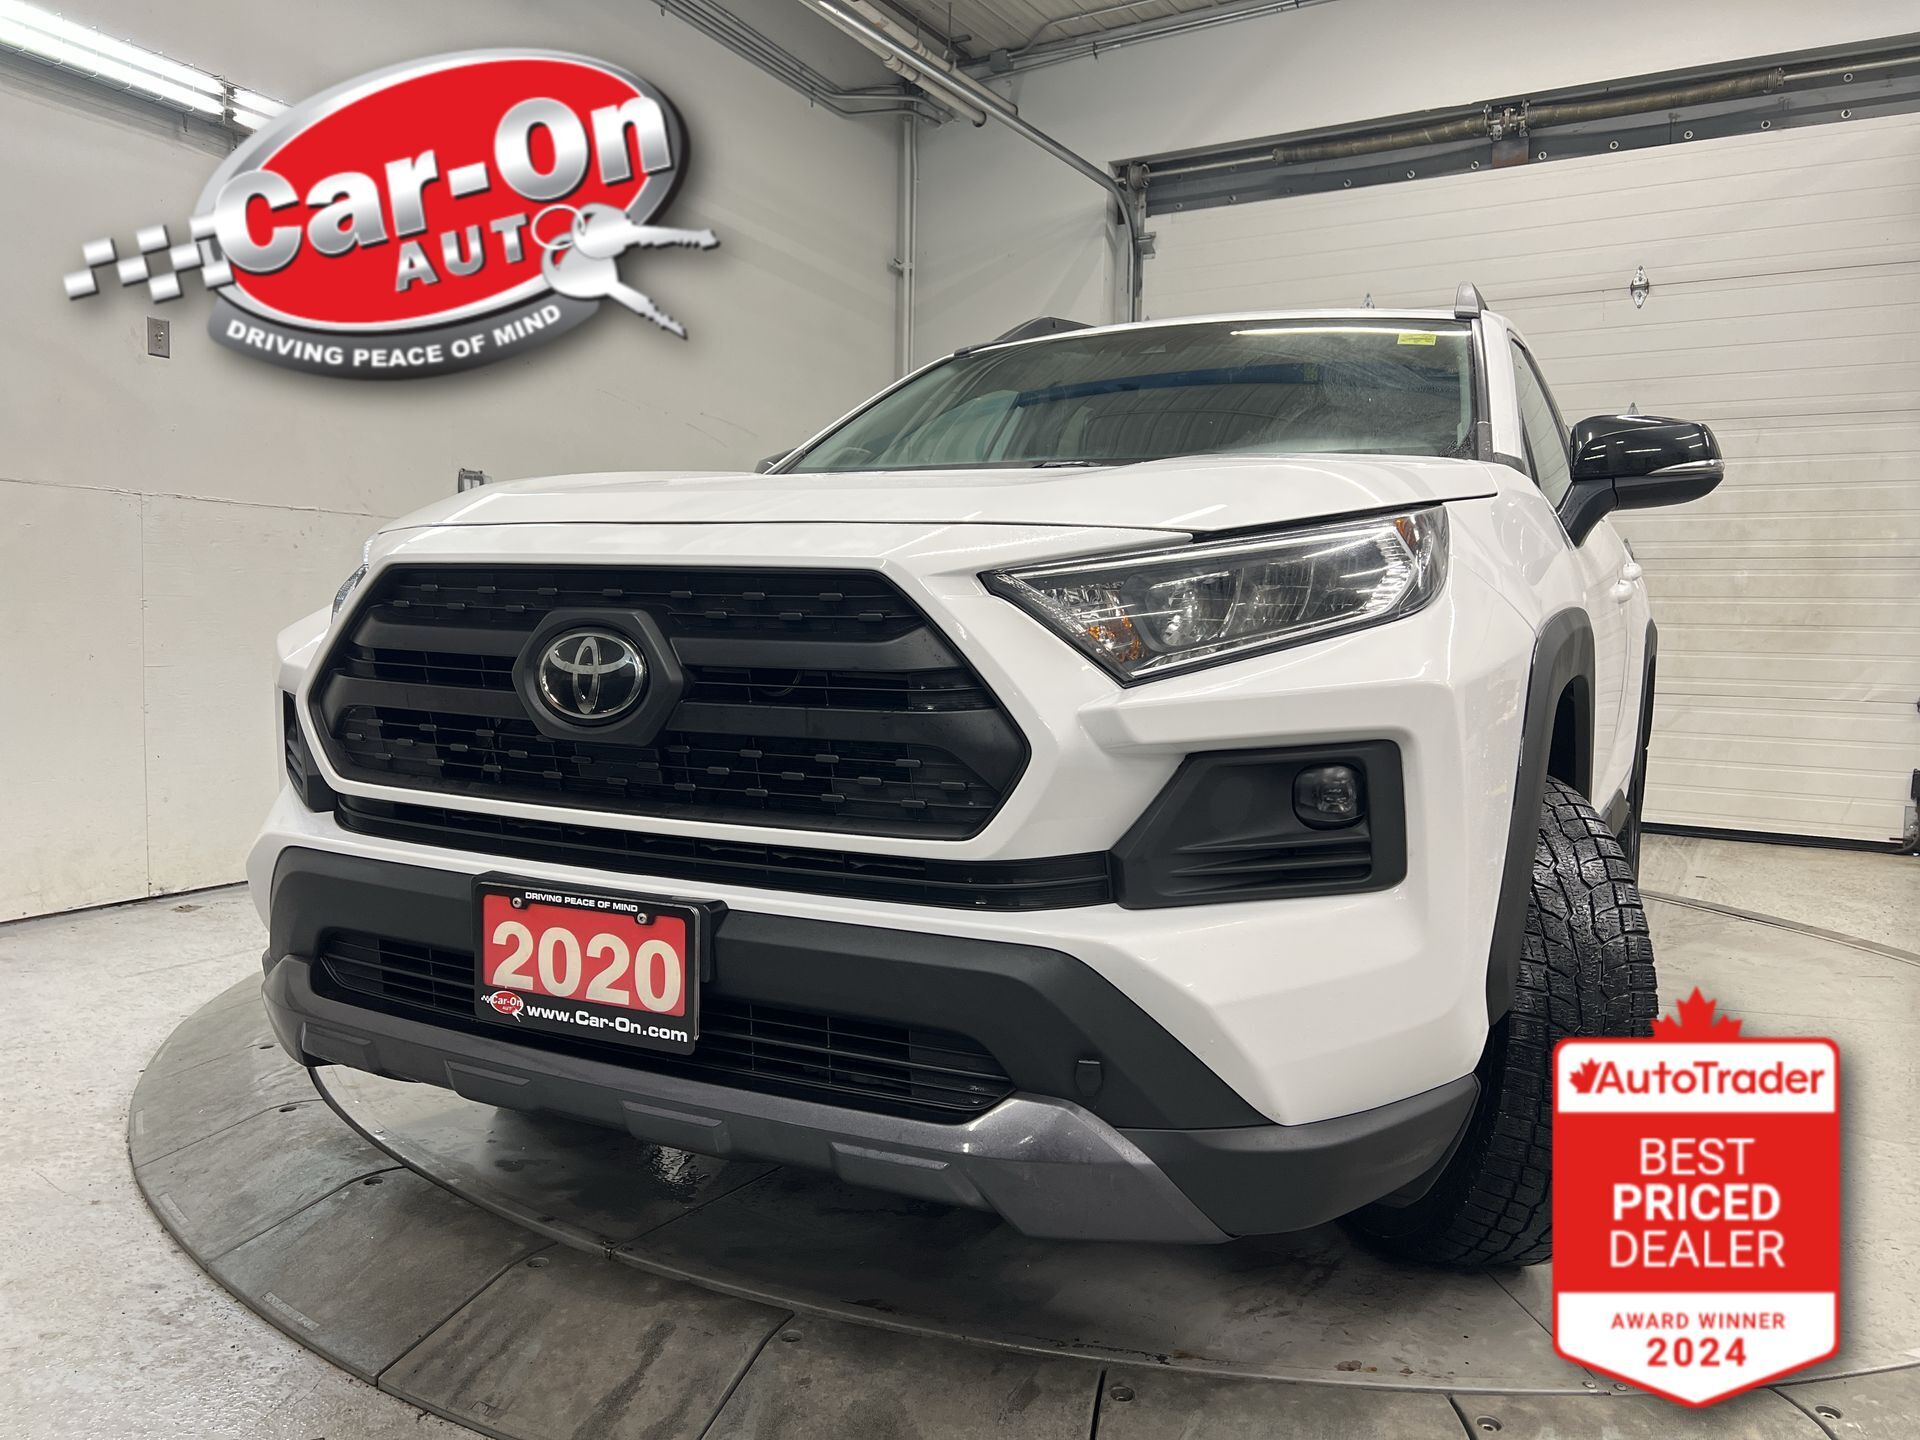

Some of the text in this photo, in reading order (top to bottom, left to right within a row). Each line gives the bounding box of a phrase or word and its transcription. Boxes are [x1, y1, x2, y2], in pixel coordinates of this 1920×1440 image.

[525, 892, 638, 912] DRIVING PEACE OF MIND
[492, 921, 681, 1012] 2020
[492, 995, 523, 1006] Car-On
[526, 1005, 688, 1042] www.Car-On.com
